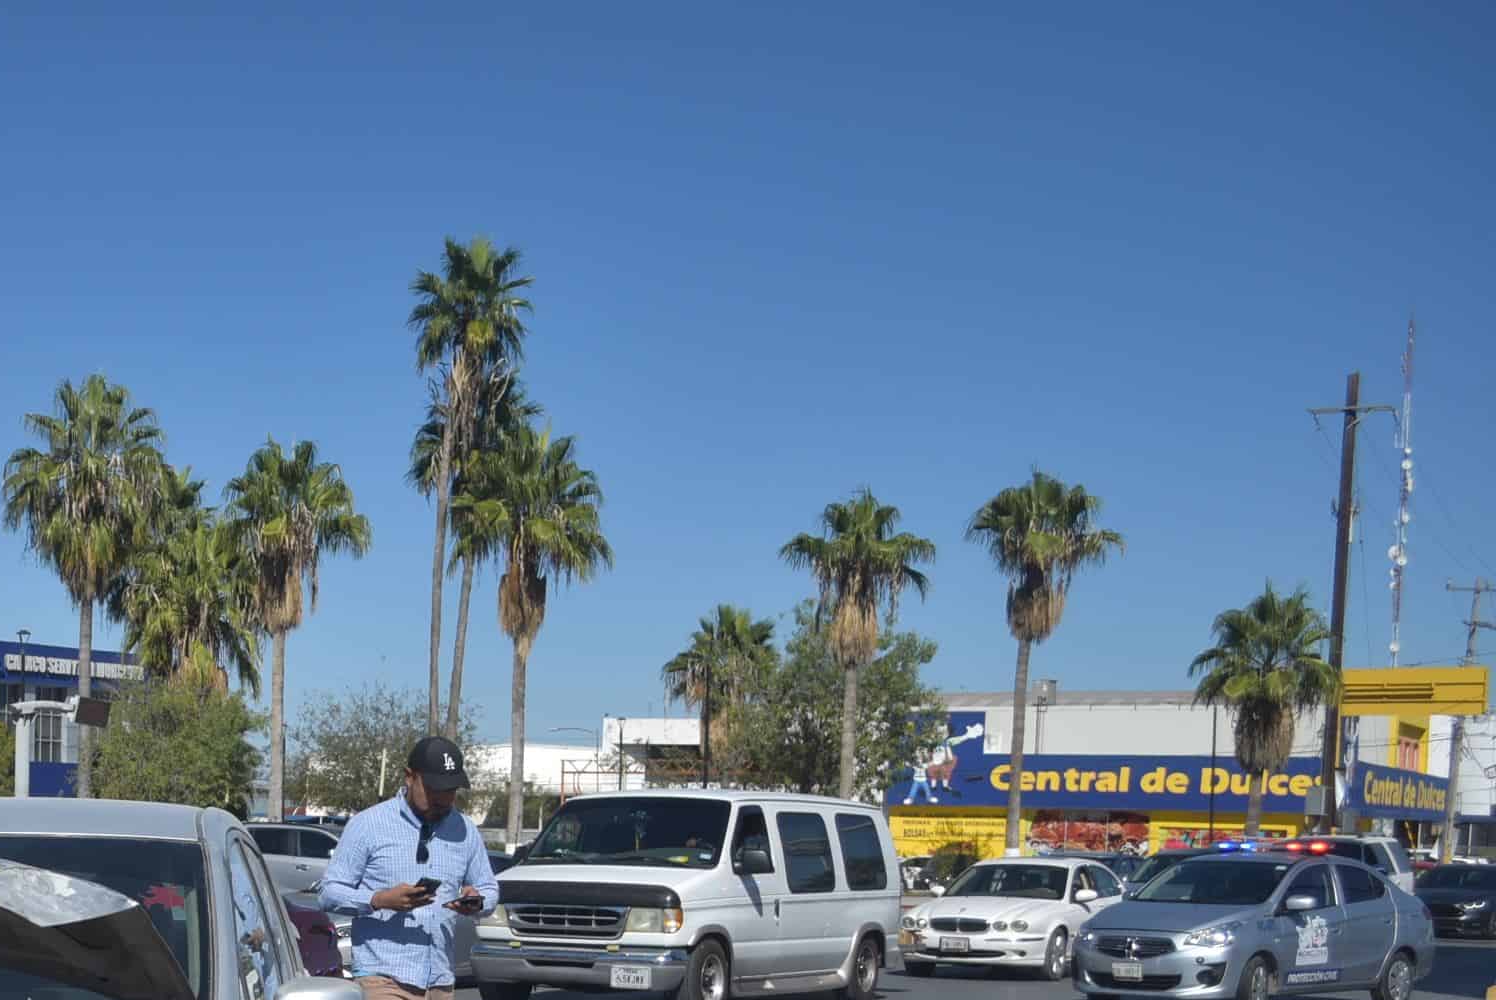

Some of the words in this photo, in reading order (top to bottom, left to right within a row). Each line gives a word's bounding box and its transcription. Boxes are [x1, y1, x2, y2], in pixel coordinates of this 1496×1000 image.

[443, 752, 456, 770] LA
[990, 764, 1130, 793] Central
[1139, 767, 1189, 794] de
[1200, 767, 1321, 797] Dulce
[1364, 770, 1403, 808] Central
[1404, 776, 1416, 809] de
